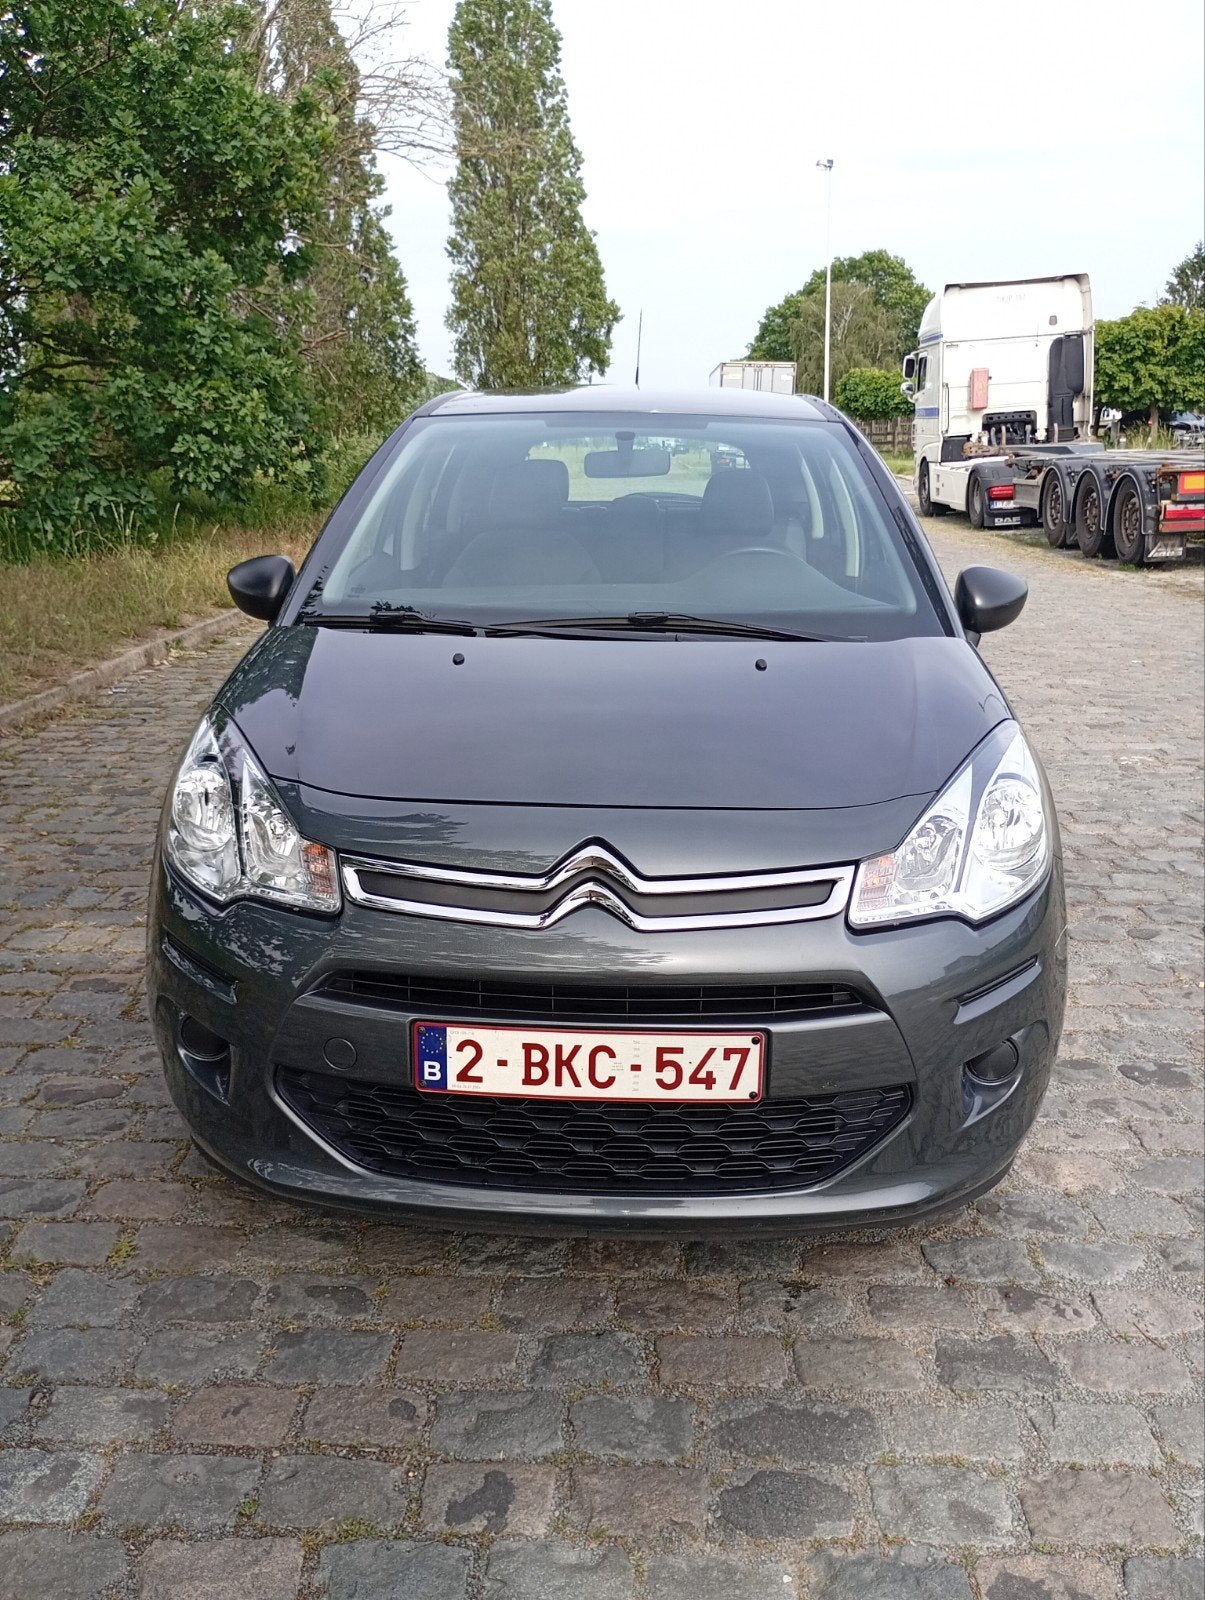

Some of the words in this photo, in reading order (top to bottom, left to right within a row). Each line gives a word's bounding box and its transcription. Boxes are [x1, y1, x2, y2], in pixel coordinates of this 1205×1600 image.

[994, 517, 1020, 525] DAF
[423, 1060, 442, 1081] B
[456, 1039, 751, 1091] 2-BKC-547
